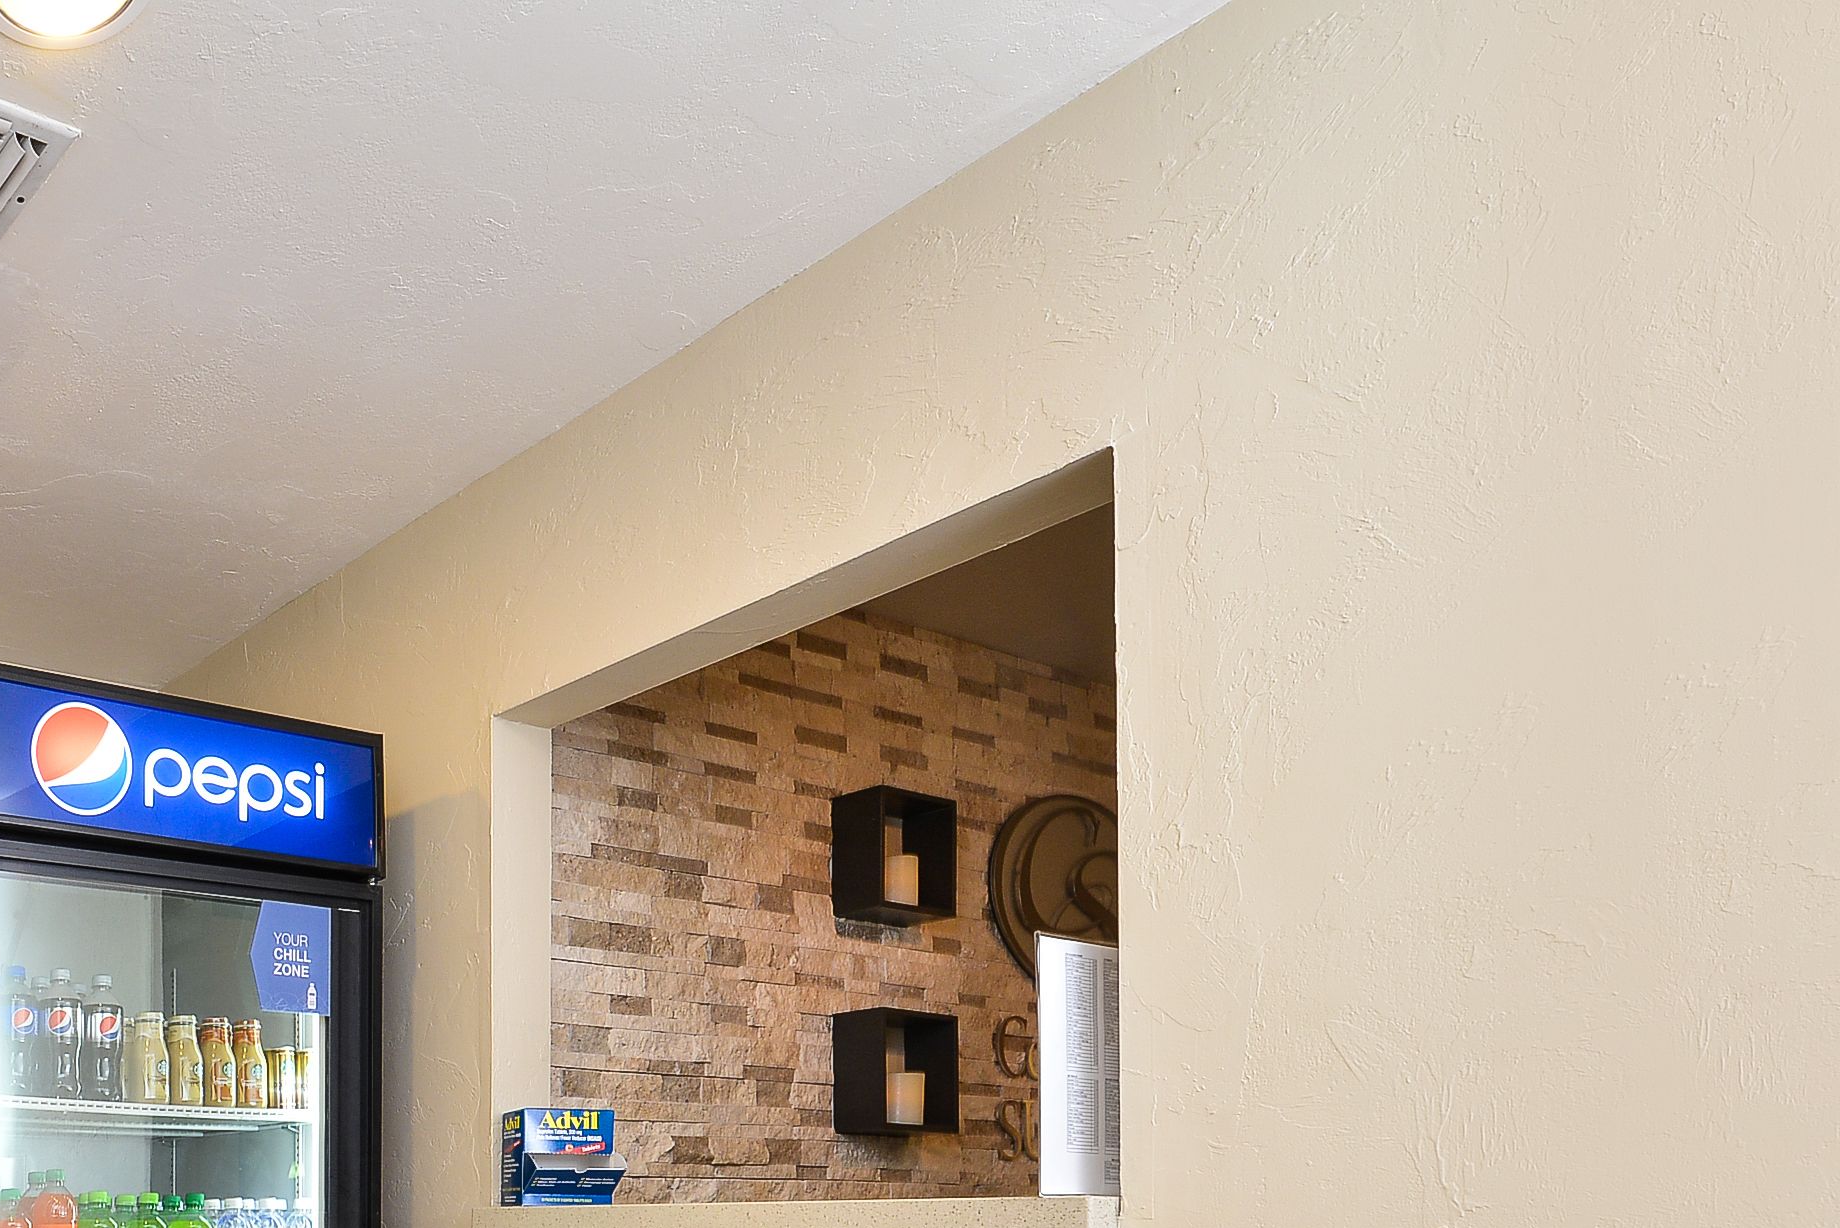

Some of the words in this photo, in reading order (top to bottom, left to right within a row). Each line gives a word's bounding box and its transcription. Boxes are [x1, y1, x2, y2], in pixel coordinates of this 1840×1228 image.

[144, 748, 325, 822] pepsi
[273, 931, 309, 947] YOUR
[273, 948, 312, 963] CHILL
[273, 963, 310, 978] ZONE
[504, 1115, 521, 1131] Advil
[539, 1110, 599, 1130] Advil
